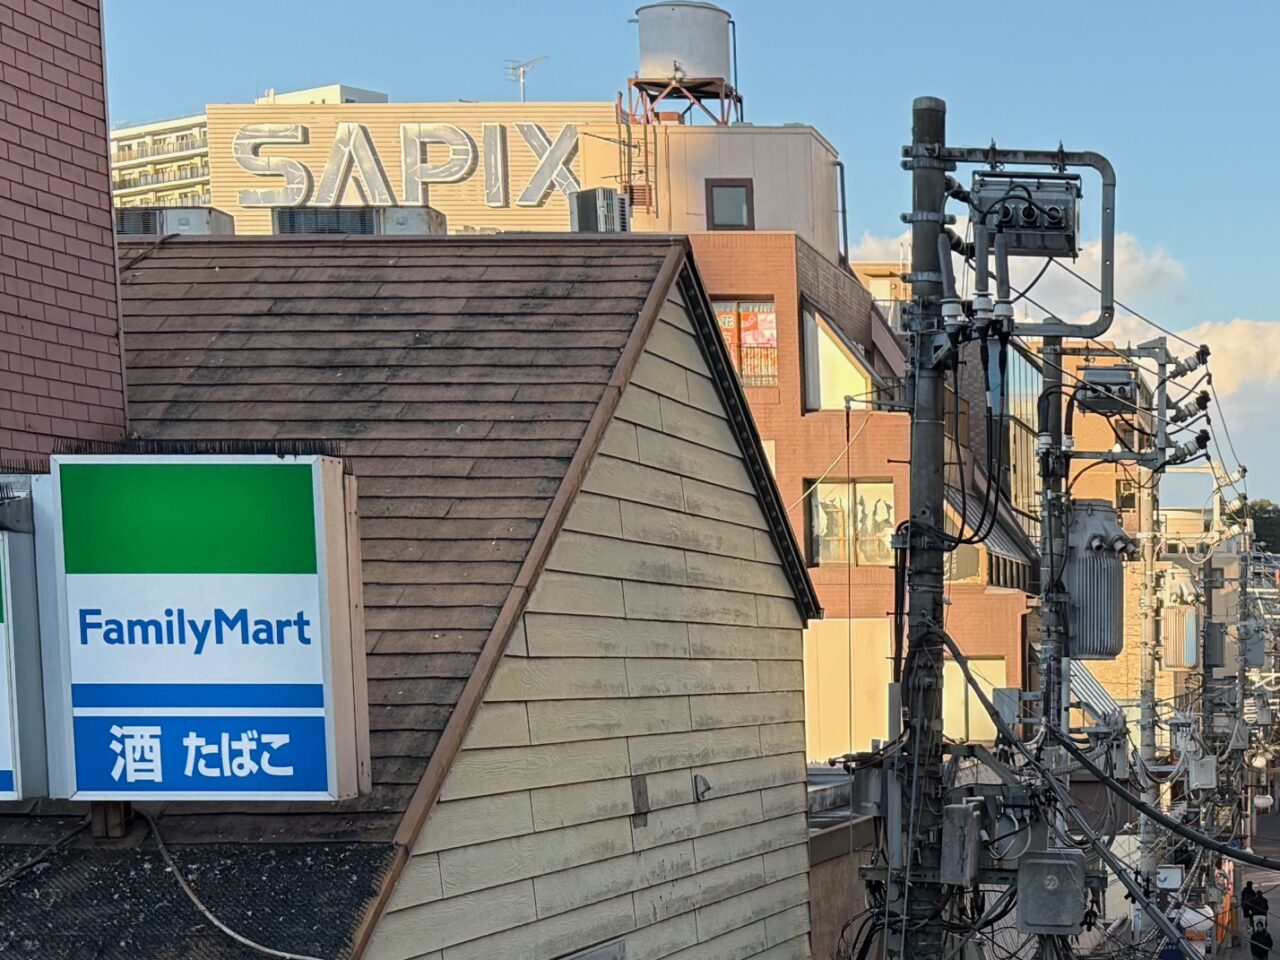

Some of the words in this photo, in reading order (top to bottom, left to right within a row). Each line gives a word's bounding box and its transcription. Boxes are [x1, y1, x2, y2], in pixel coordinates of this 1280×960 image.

[231, 121, 582, 209] SAPIX
[79, 608, 312, 655] FamilyMart
[109, 724, 164, 783] 酒
[182, 730, 294, 778] たばこ
